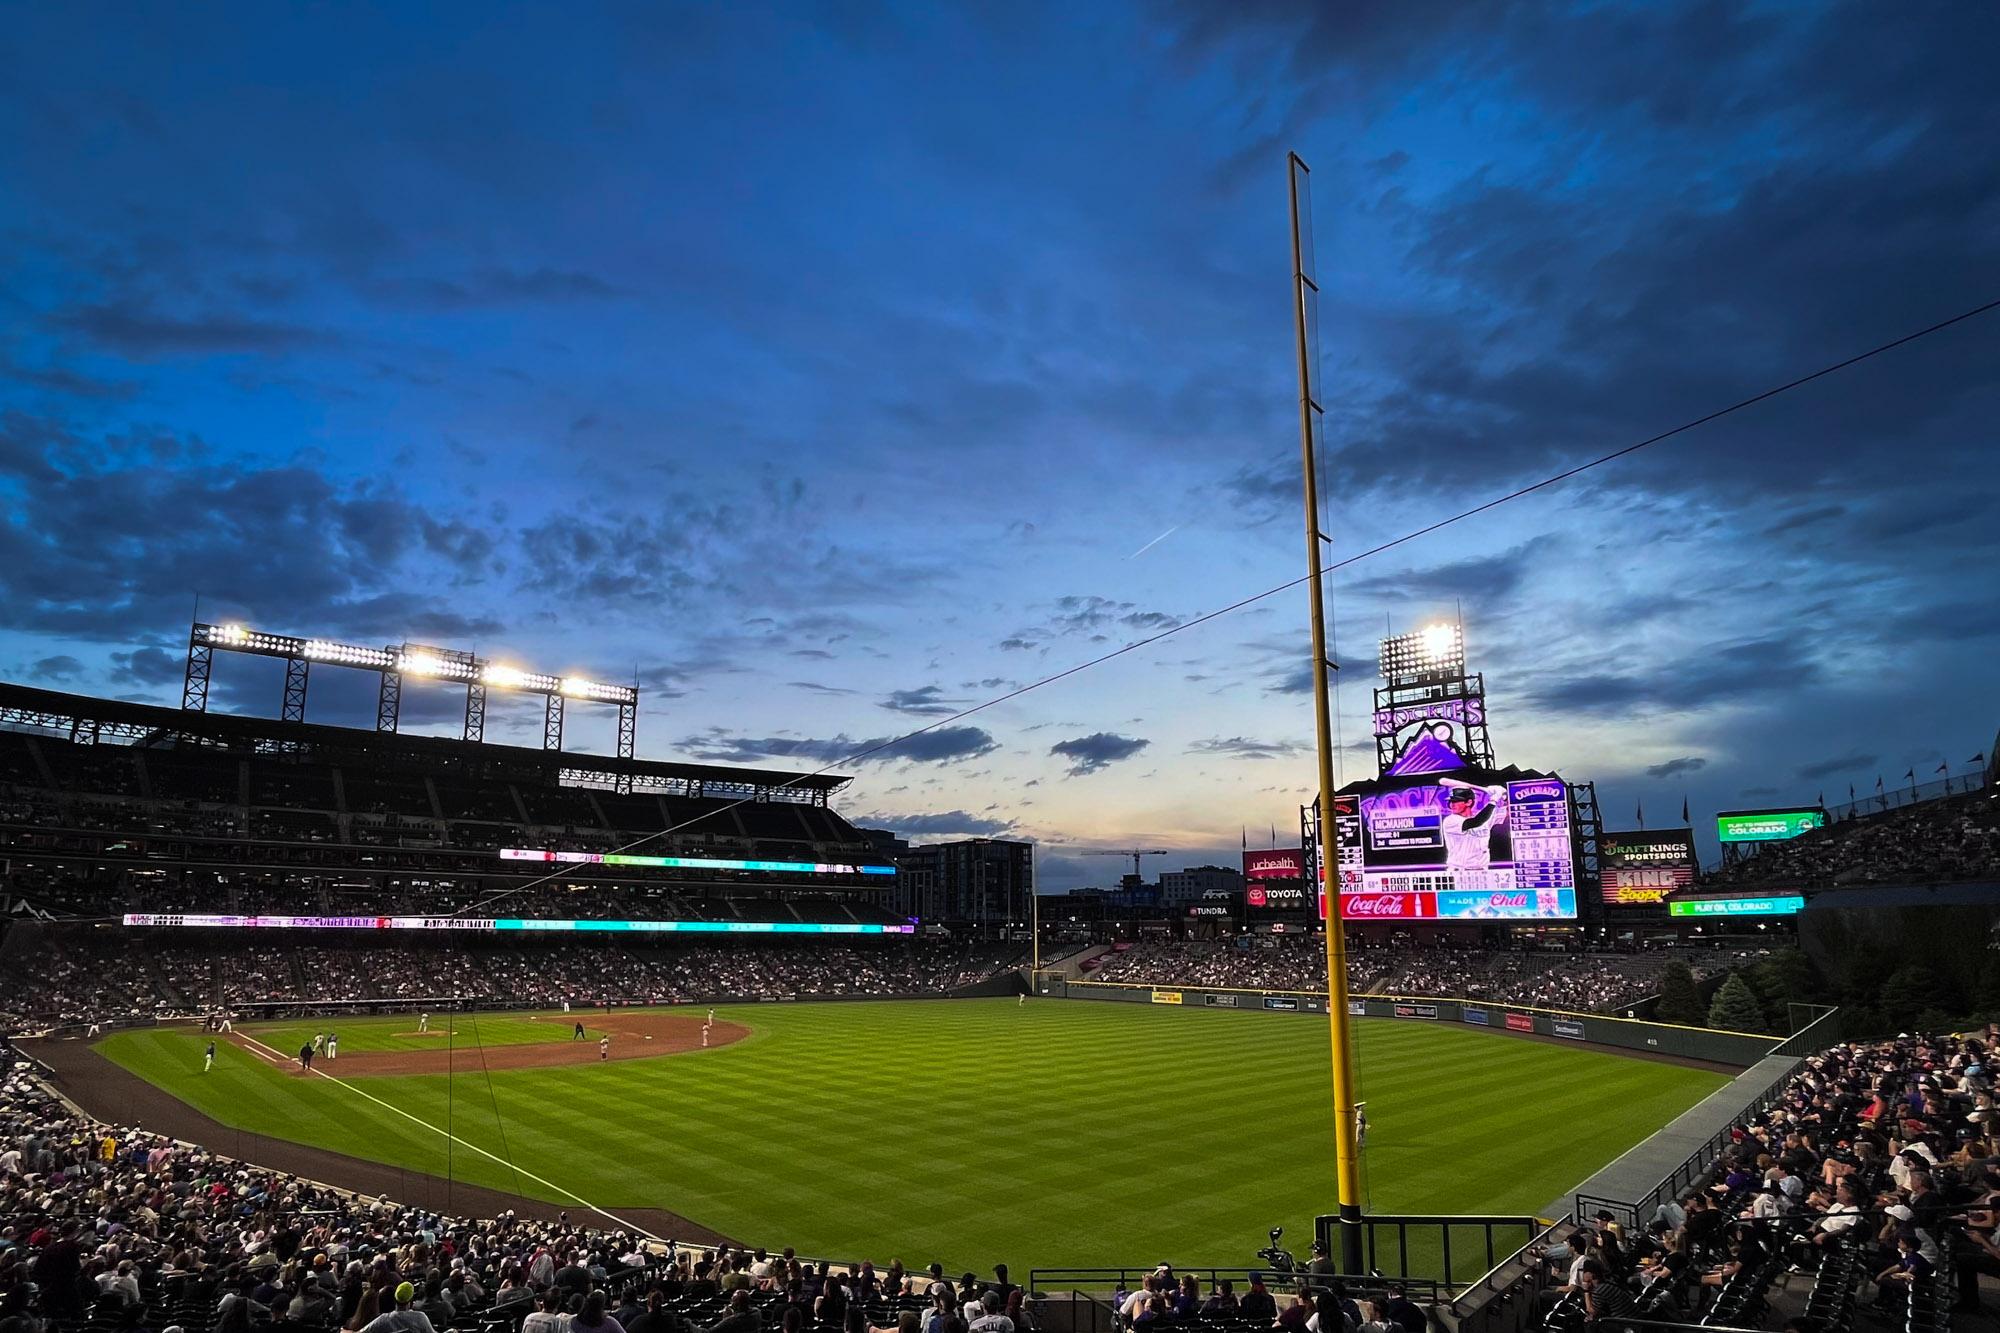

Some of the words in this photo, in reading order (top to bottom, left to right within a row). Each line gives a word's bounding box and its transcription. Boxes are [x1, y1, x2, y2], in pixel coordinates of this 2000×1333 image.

[1375, 699, 1482, 735] ROCKIES
[1515, 786, 1560, 800] COLORADO
[1374, 817, 1415, 830] MCMAHON
[1728, 826, 1788, 835] COLORADO
[1605, 843, 1688, 855] DRAFTKINGS
[1624, 852, 1688, 861] SPORTSBOOK
[1253, 857, 1295, 869] uchealth
[1616, 871, 1675, 887] KING
[1265, 890, 1303, 899] TOYOTA
[1490, 893, 1528, 907] Chill
[1197, 907, 1227, 915] TUNDRA
[1347, 895, 1404, 915] Coca-Cola
[1728, 902, 1774, 911] COLORADO
